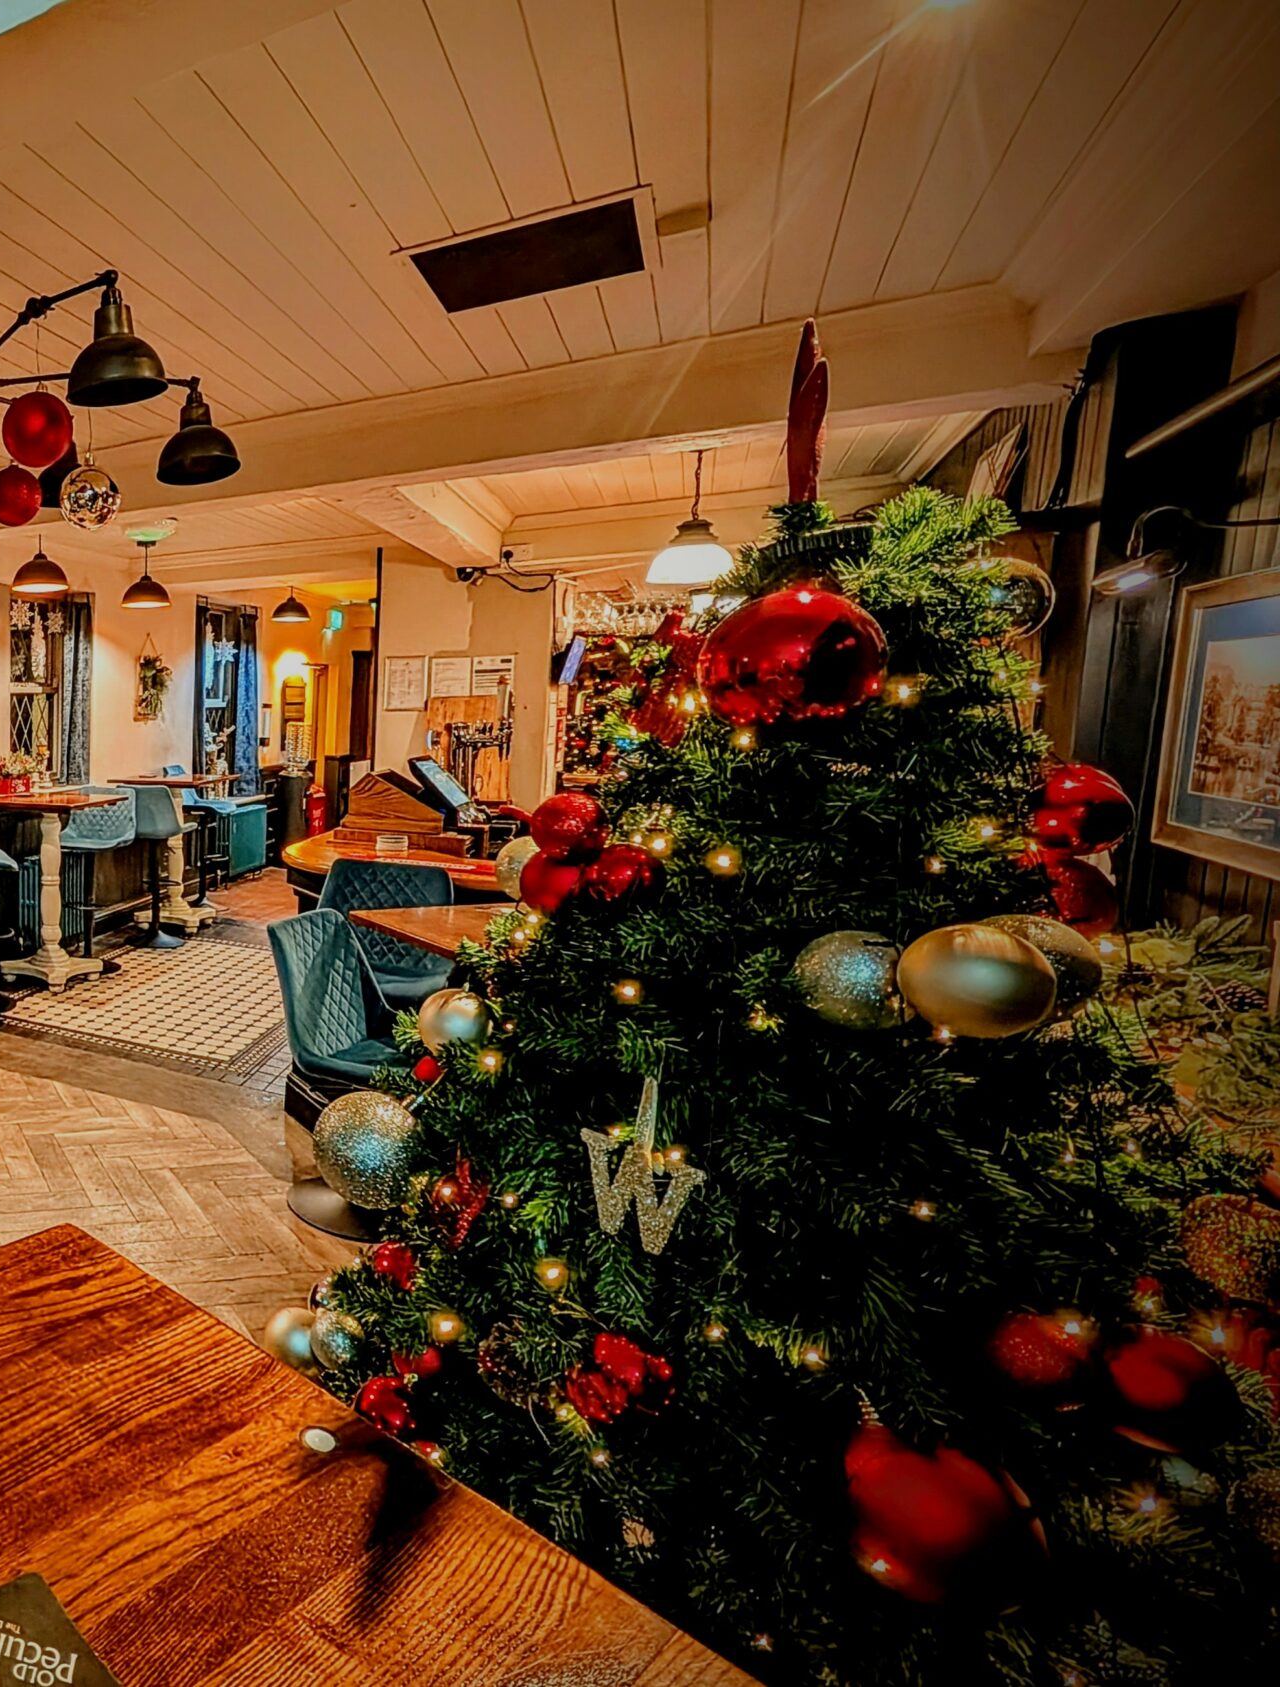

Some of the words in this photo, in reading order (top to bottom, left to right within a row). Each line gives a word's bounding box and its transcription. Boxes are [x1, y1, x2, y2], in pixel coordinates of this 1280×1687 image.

[579, 1127, 708, 1257] W
[5, 1622, 21, 1635] The
[13, 1663, 54, 1687] OLD
